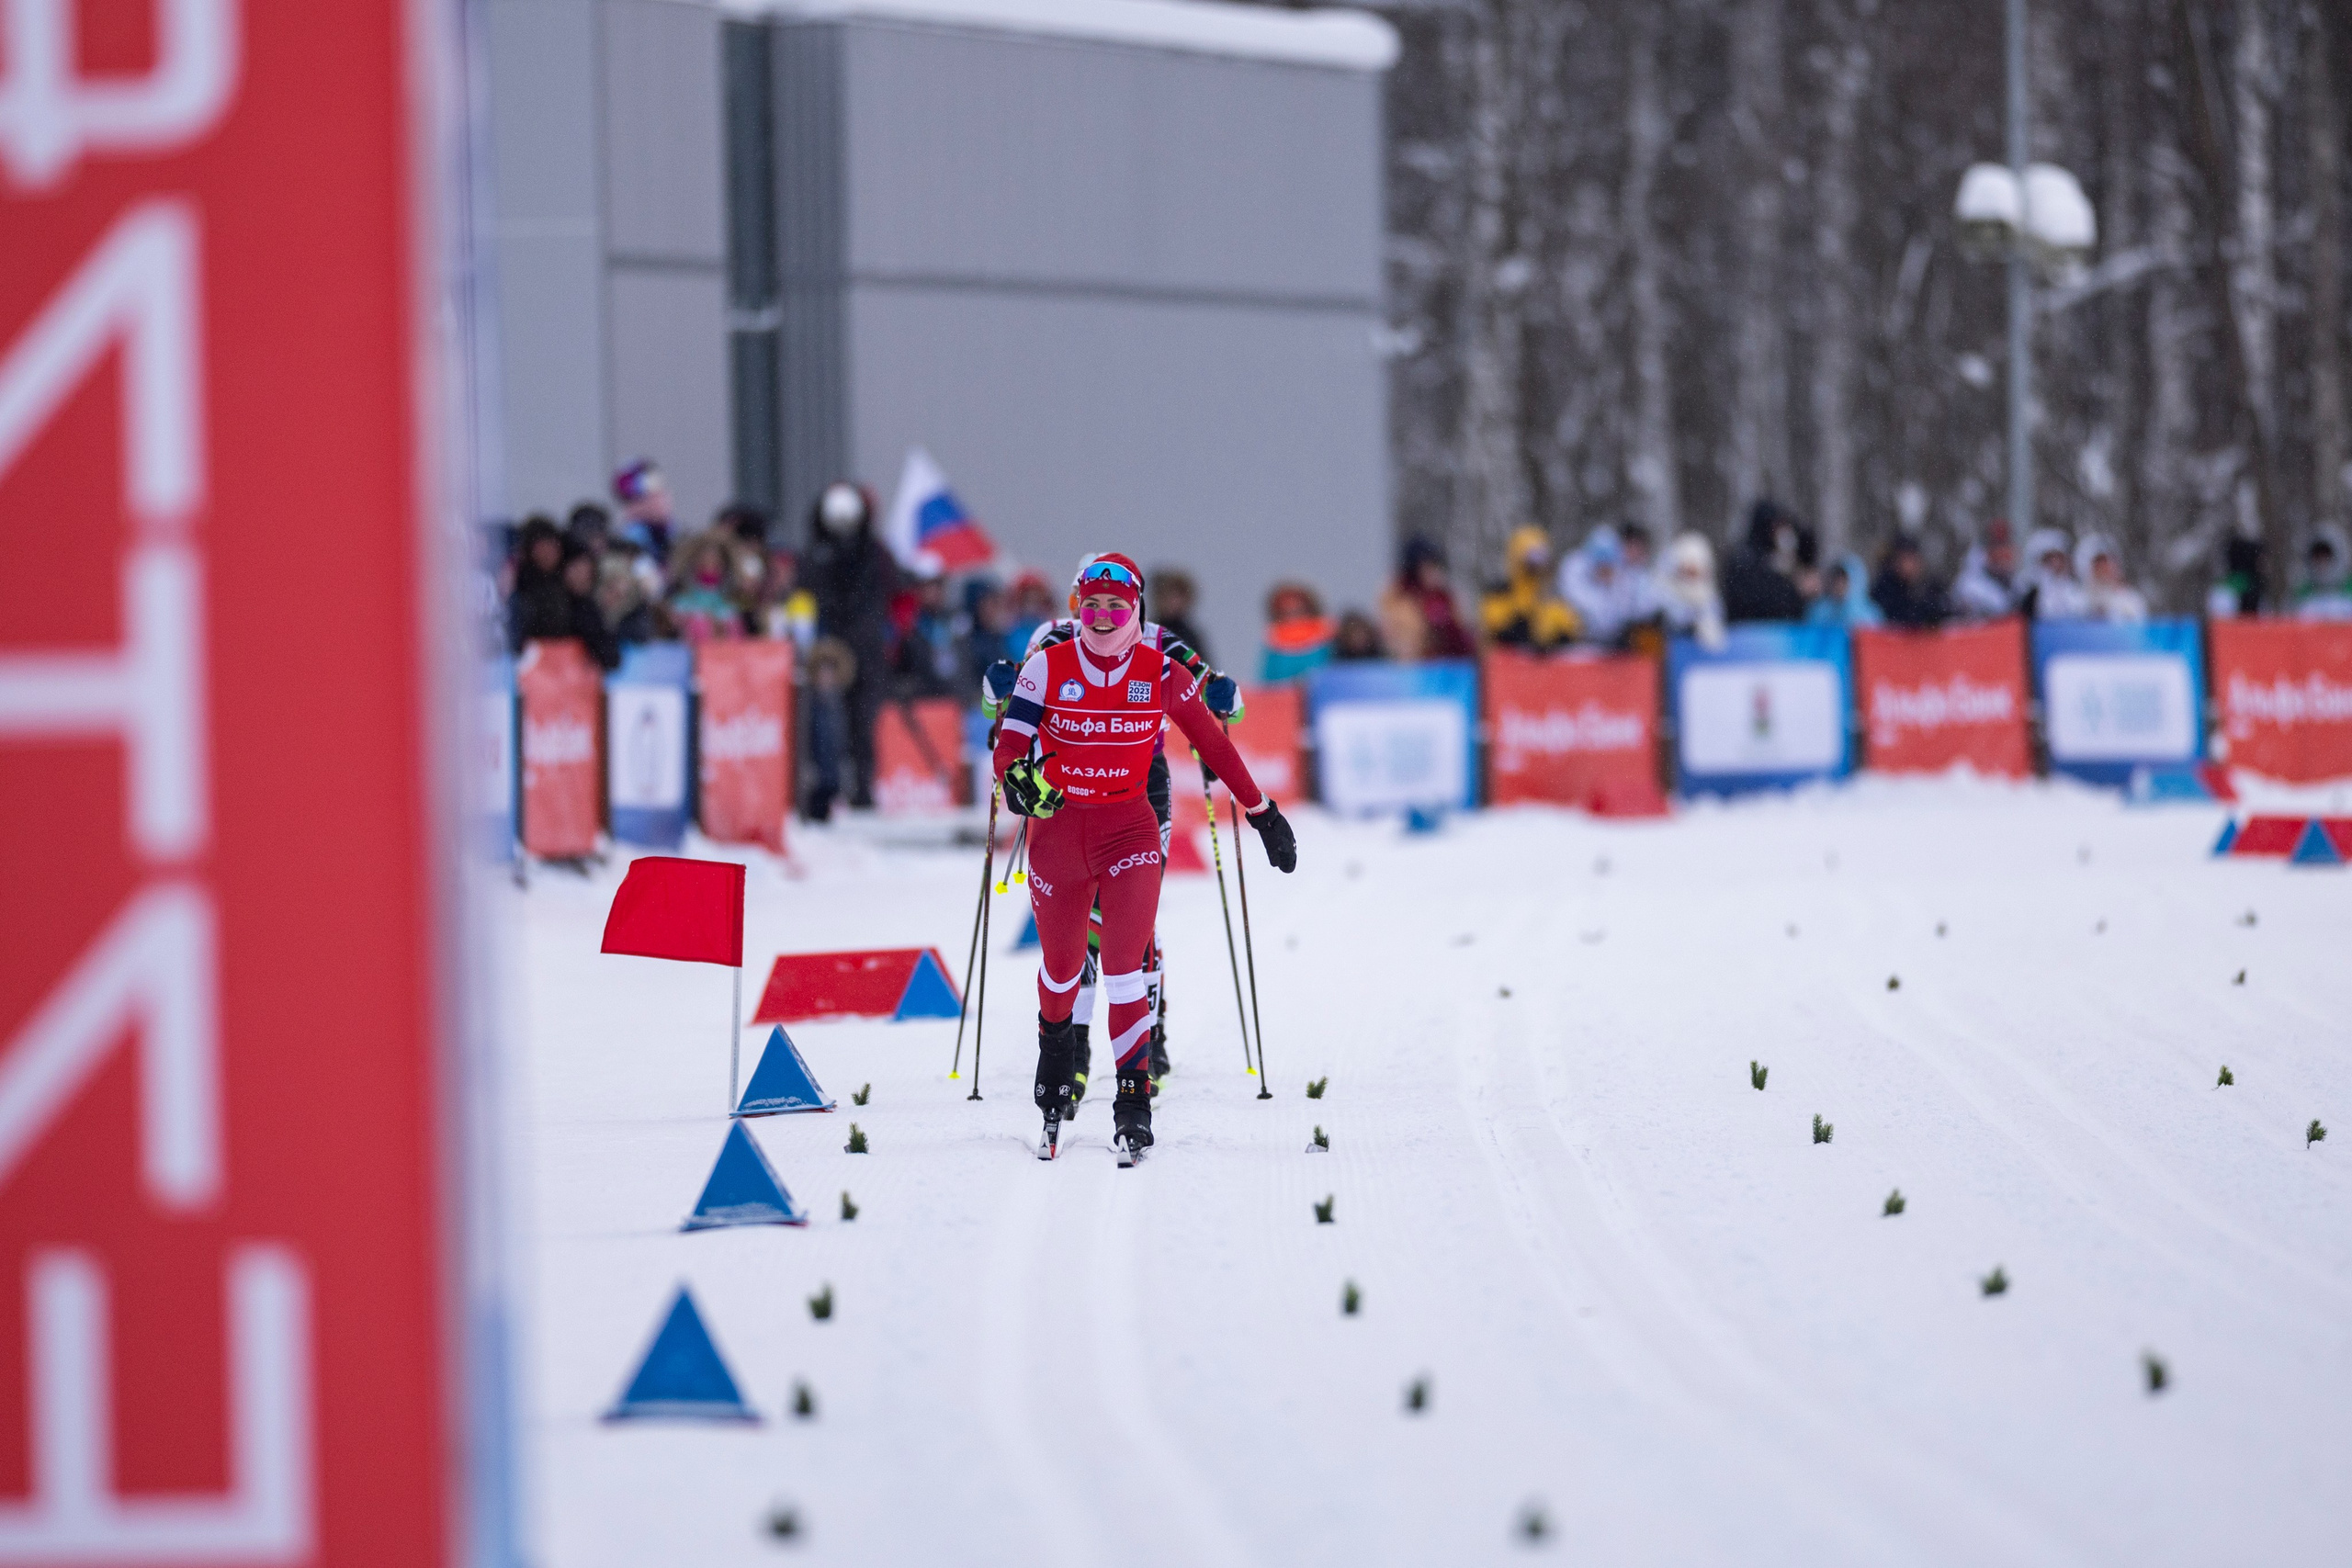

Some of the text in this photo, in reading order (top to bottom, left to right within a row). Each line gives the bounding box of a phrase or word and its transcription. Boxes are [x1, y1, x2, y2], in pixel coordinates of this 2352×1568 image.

[1128, 687, 1150, 695] 2023
[1050, 713, 1154, 737] Альфа Банк
[1061, 764, 1130, 778] КАЗАНЬ
[1068, 784, 1090, 796] BOSCO
[1108, 851, 1159, 877] BOSCO
